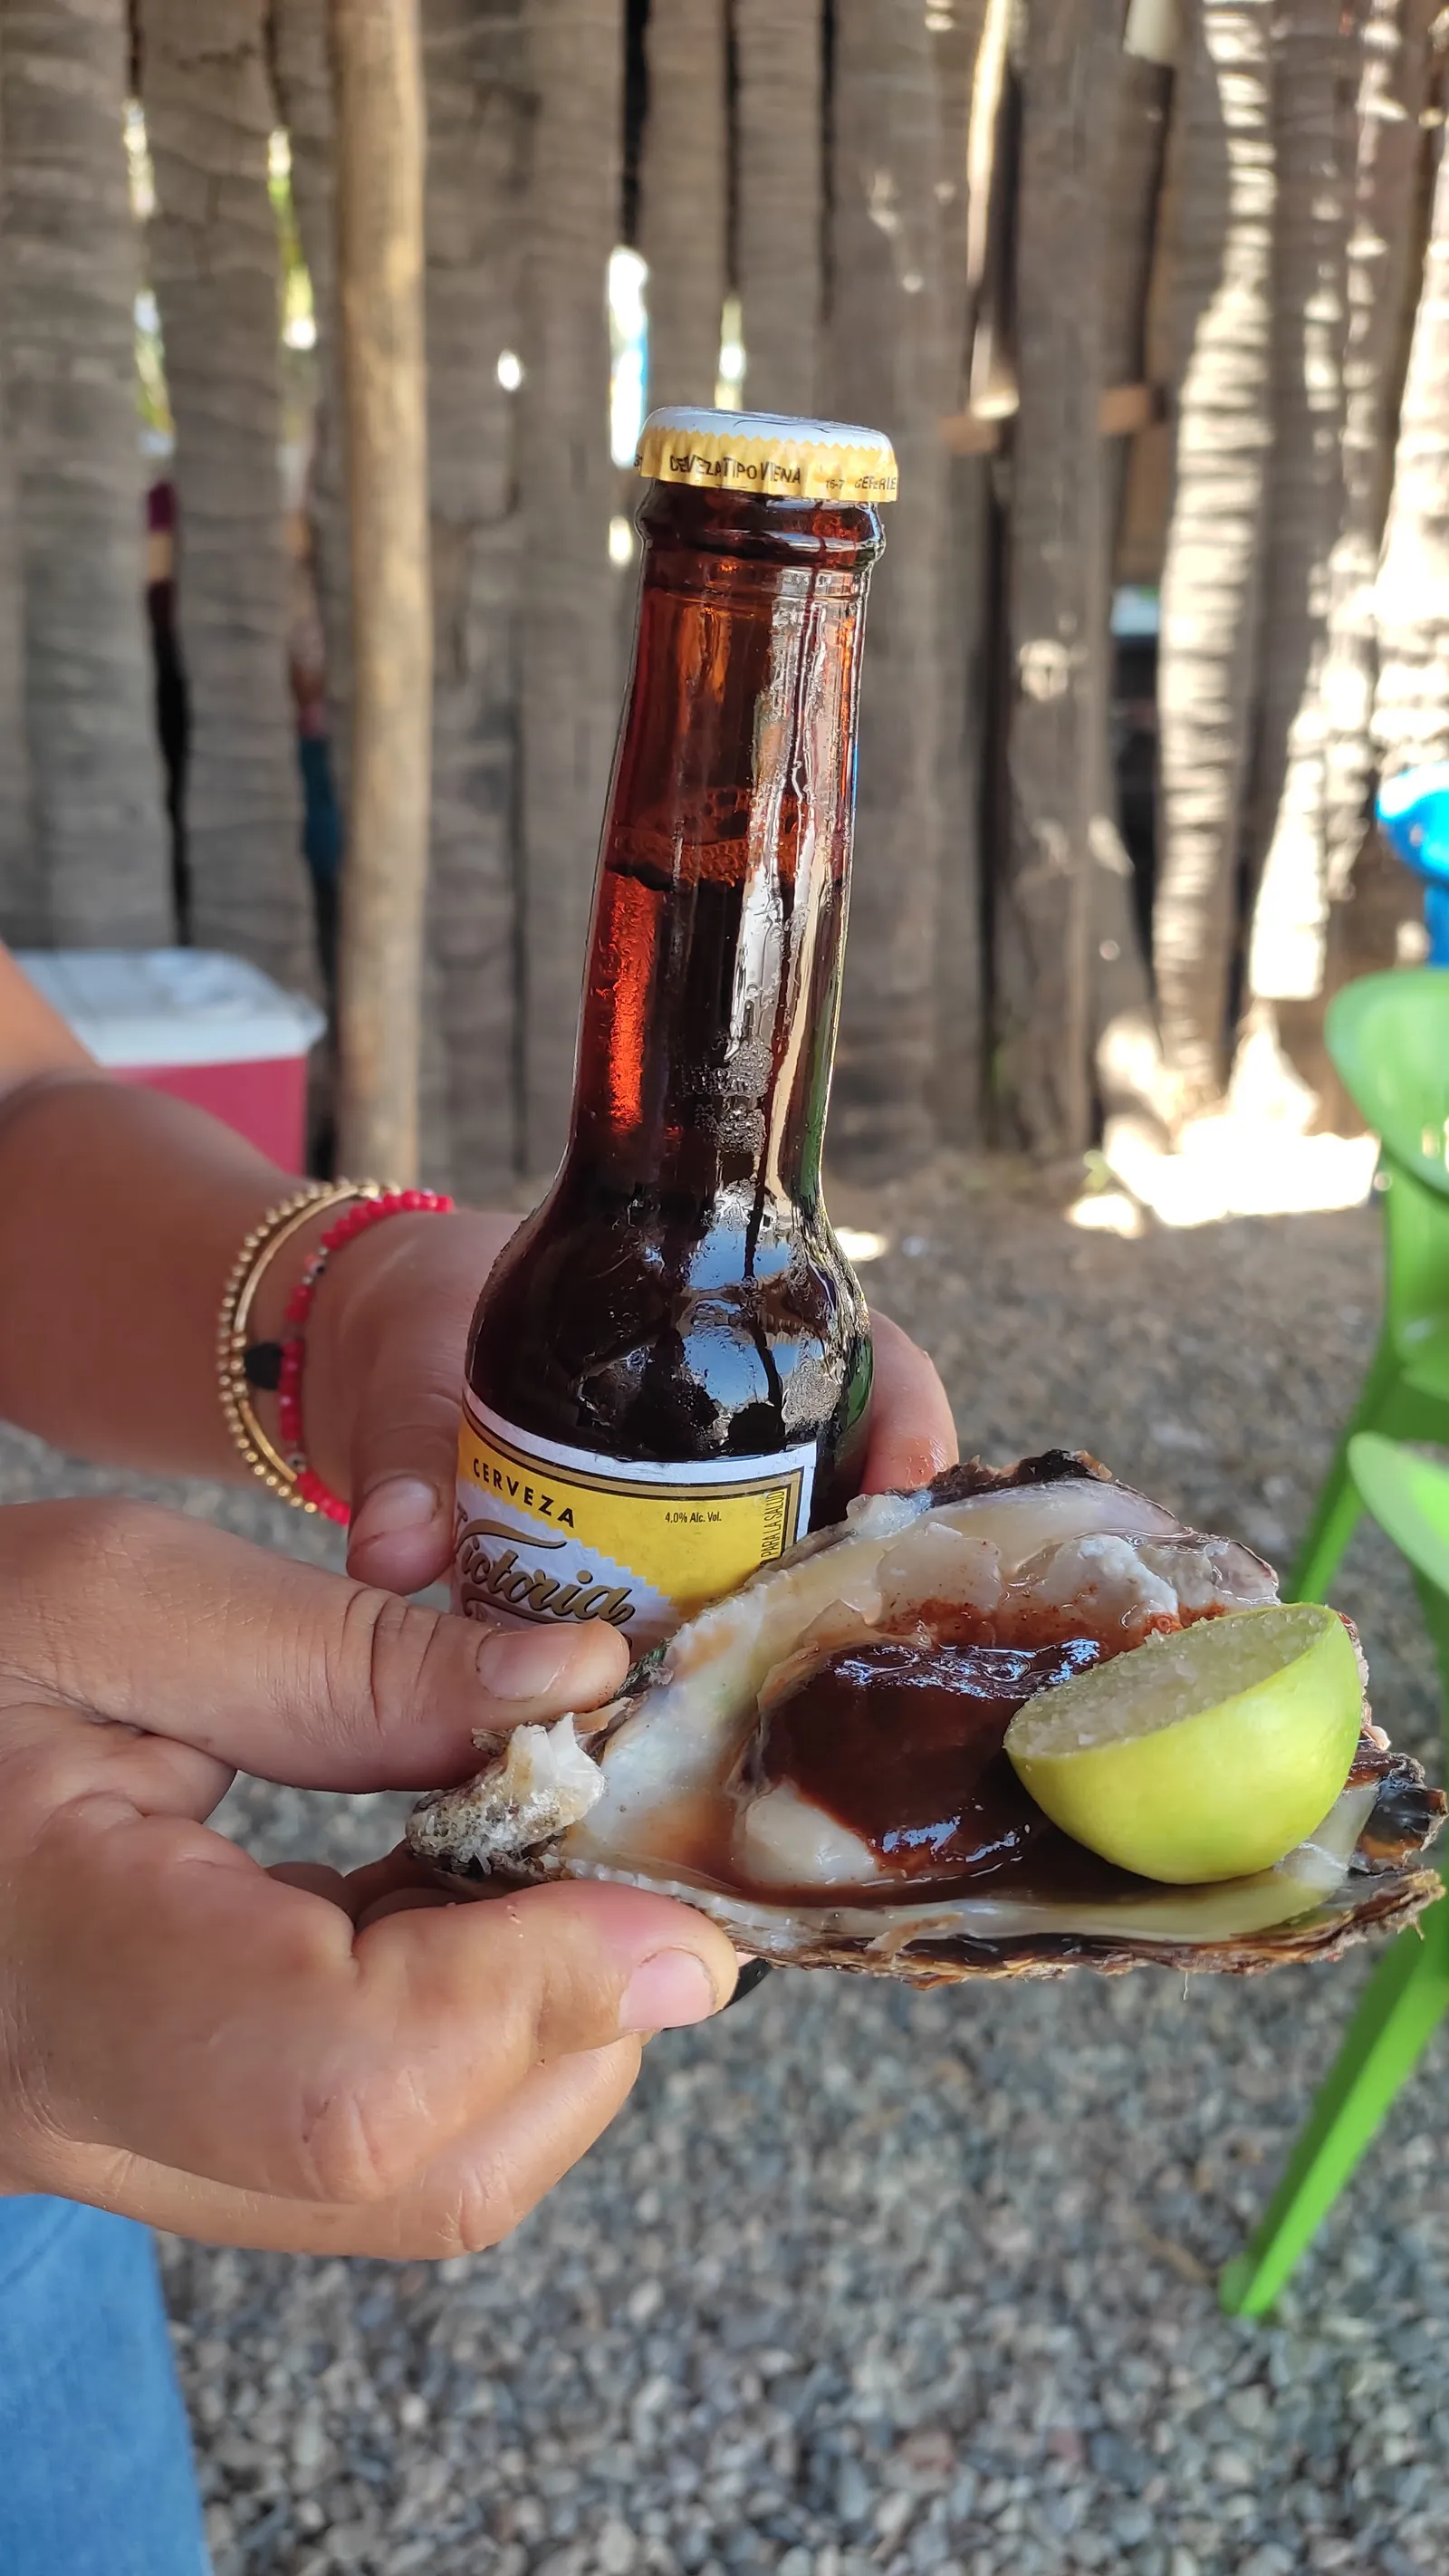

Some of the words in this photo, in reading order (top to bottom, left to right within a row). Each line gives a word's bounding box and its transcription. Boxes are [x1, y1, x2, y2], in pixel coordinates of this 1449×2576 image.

[723, 457, 758, 480] TIPO
[761, 461, 801, 484] VIENA
[473, 1457, 575, 1529] CERVEZA
[764, 1491, 785, 1521] SALUD
[689, 1512, 705, 1523] Alc.
[706, 1511, 722, 1523] Vol.
[763, 1519, 782, 1534] LA
[761, 1533, 780, 1558] PARA
